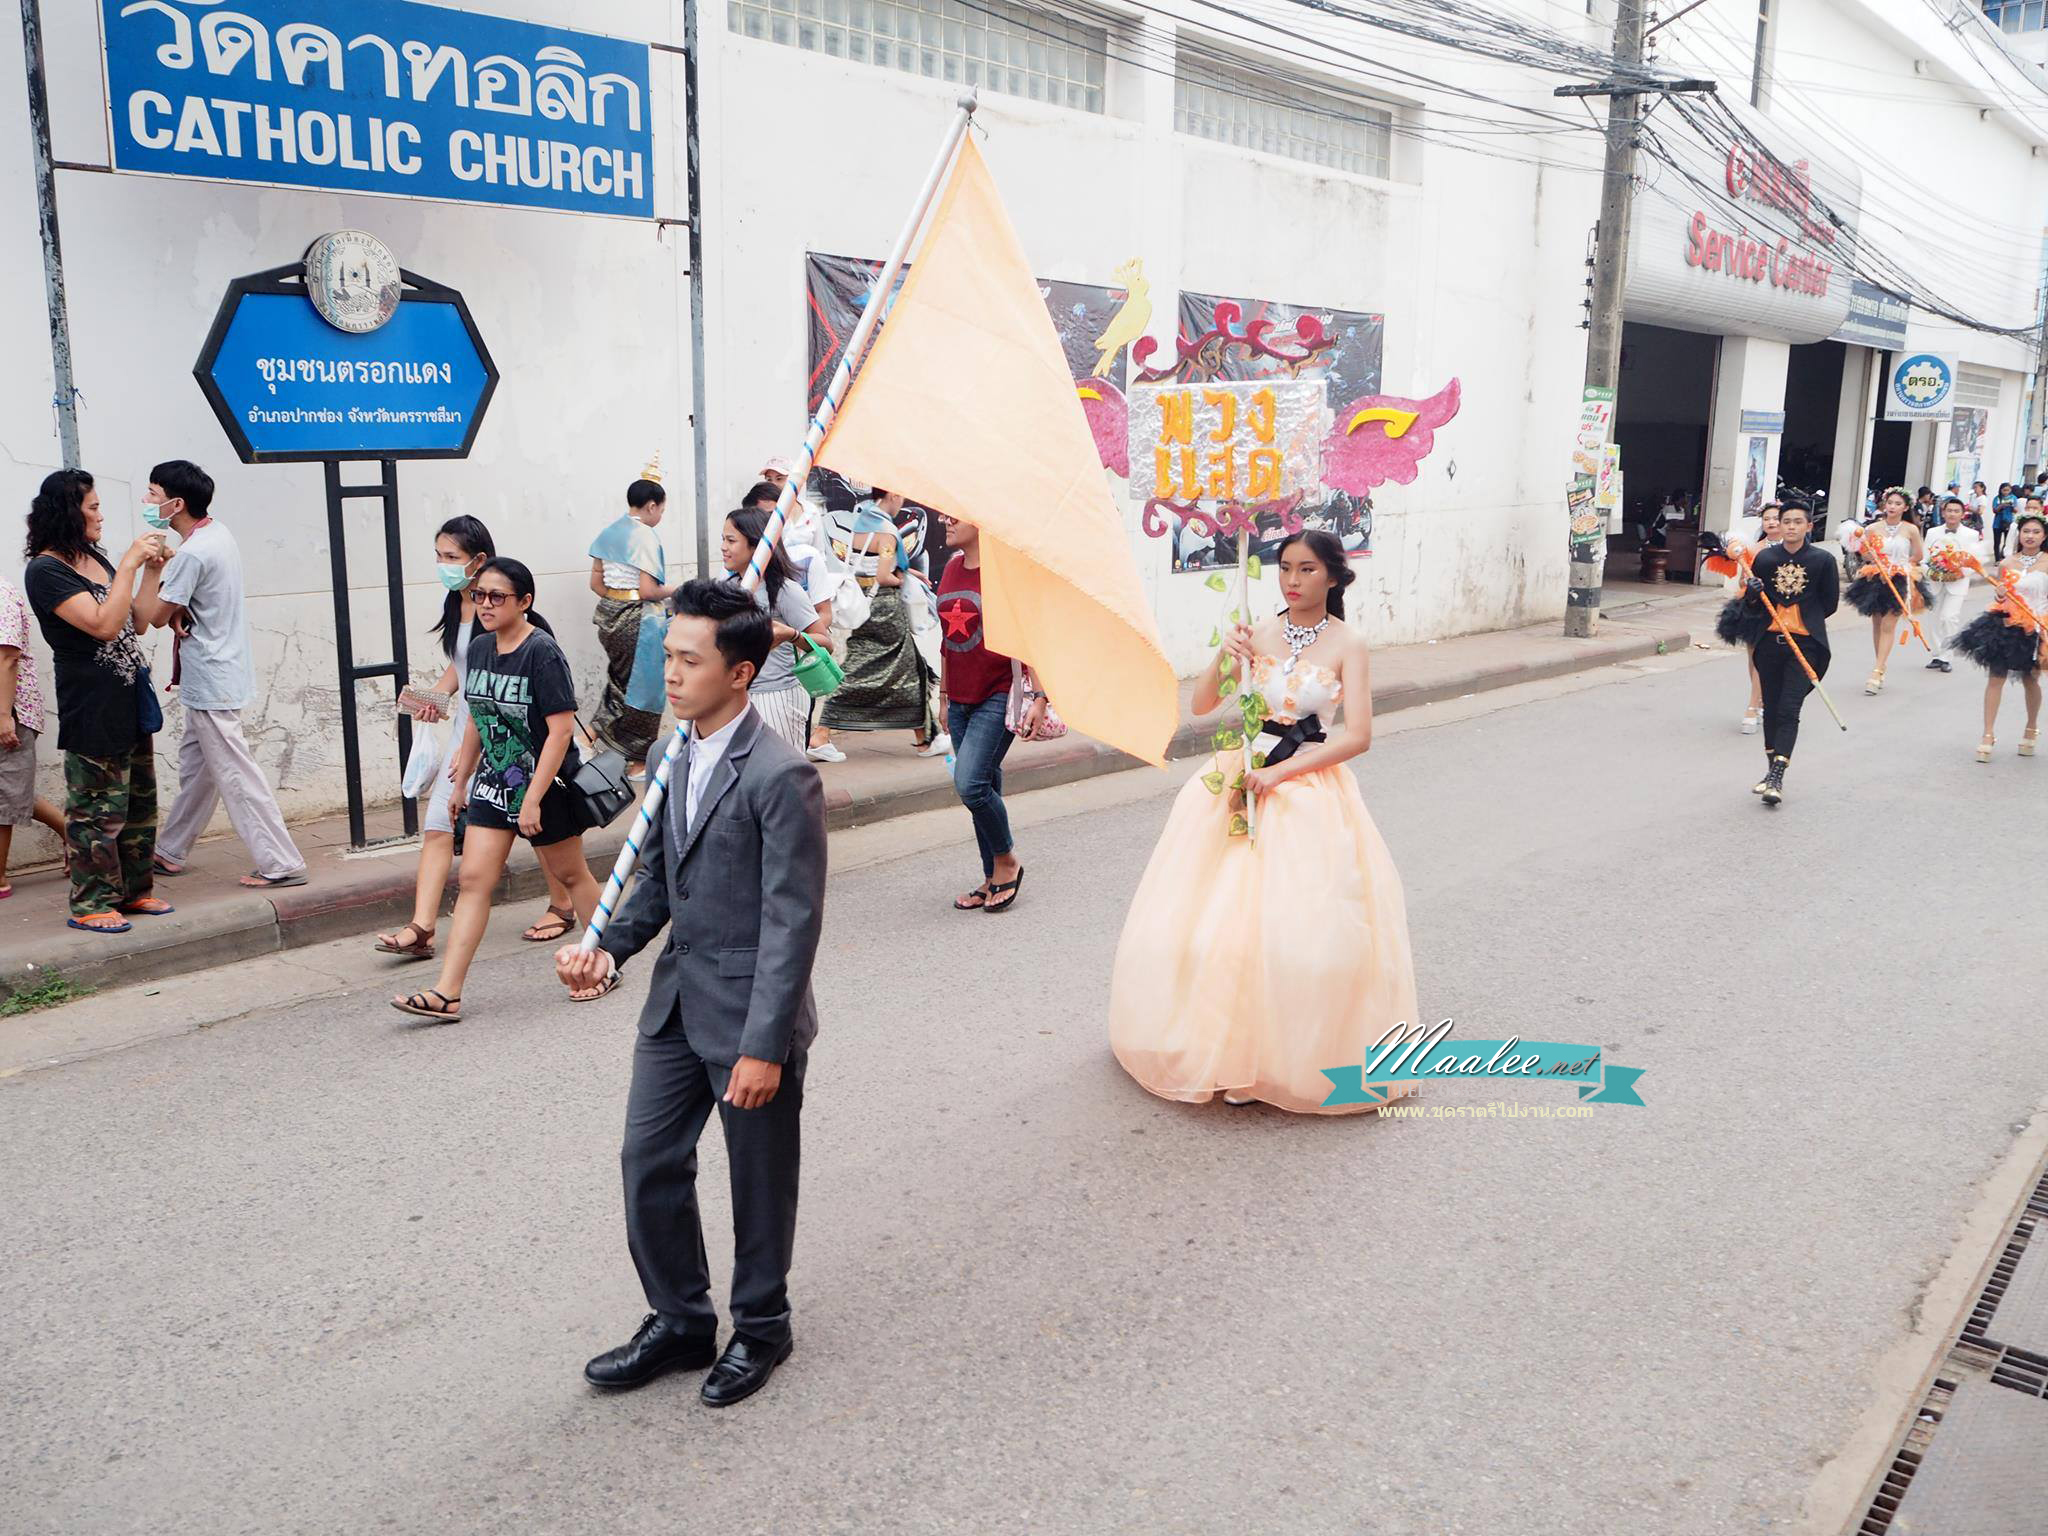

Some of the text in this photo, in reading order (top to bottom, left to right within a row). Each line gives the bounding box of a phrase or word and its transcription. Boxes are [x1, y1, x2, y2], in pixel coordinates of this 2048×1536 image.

[120, 0, 641, 132] วดคาทอลิก
[128, 89, 644, 200] CATHOLIC CHURCH
[1687, 211, 1768, 282] Service
[1773, 237, 1832, 297] Center
[256, 357, 452, 395] ชุมชนตรอกแดง
[1908, 376, 1941, 387] ตรอ.
[248, 404, 461, 424] อำเภอปากช่อง จังหวัดนครราชสีมา
[1154, 386, 1276, 445] พวง
[1153, 444, 1283, 500] แสด
